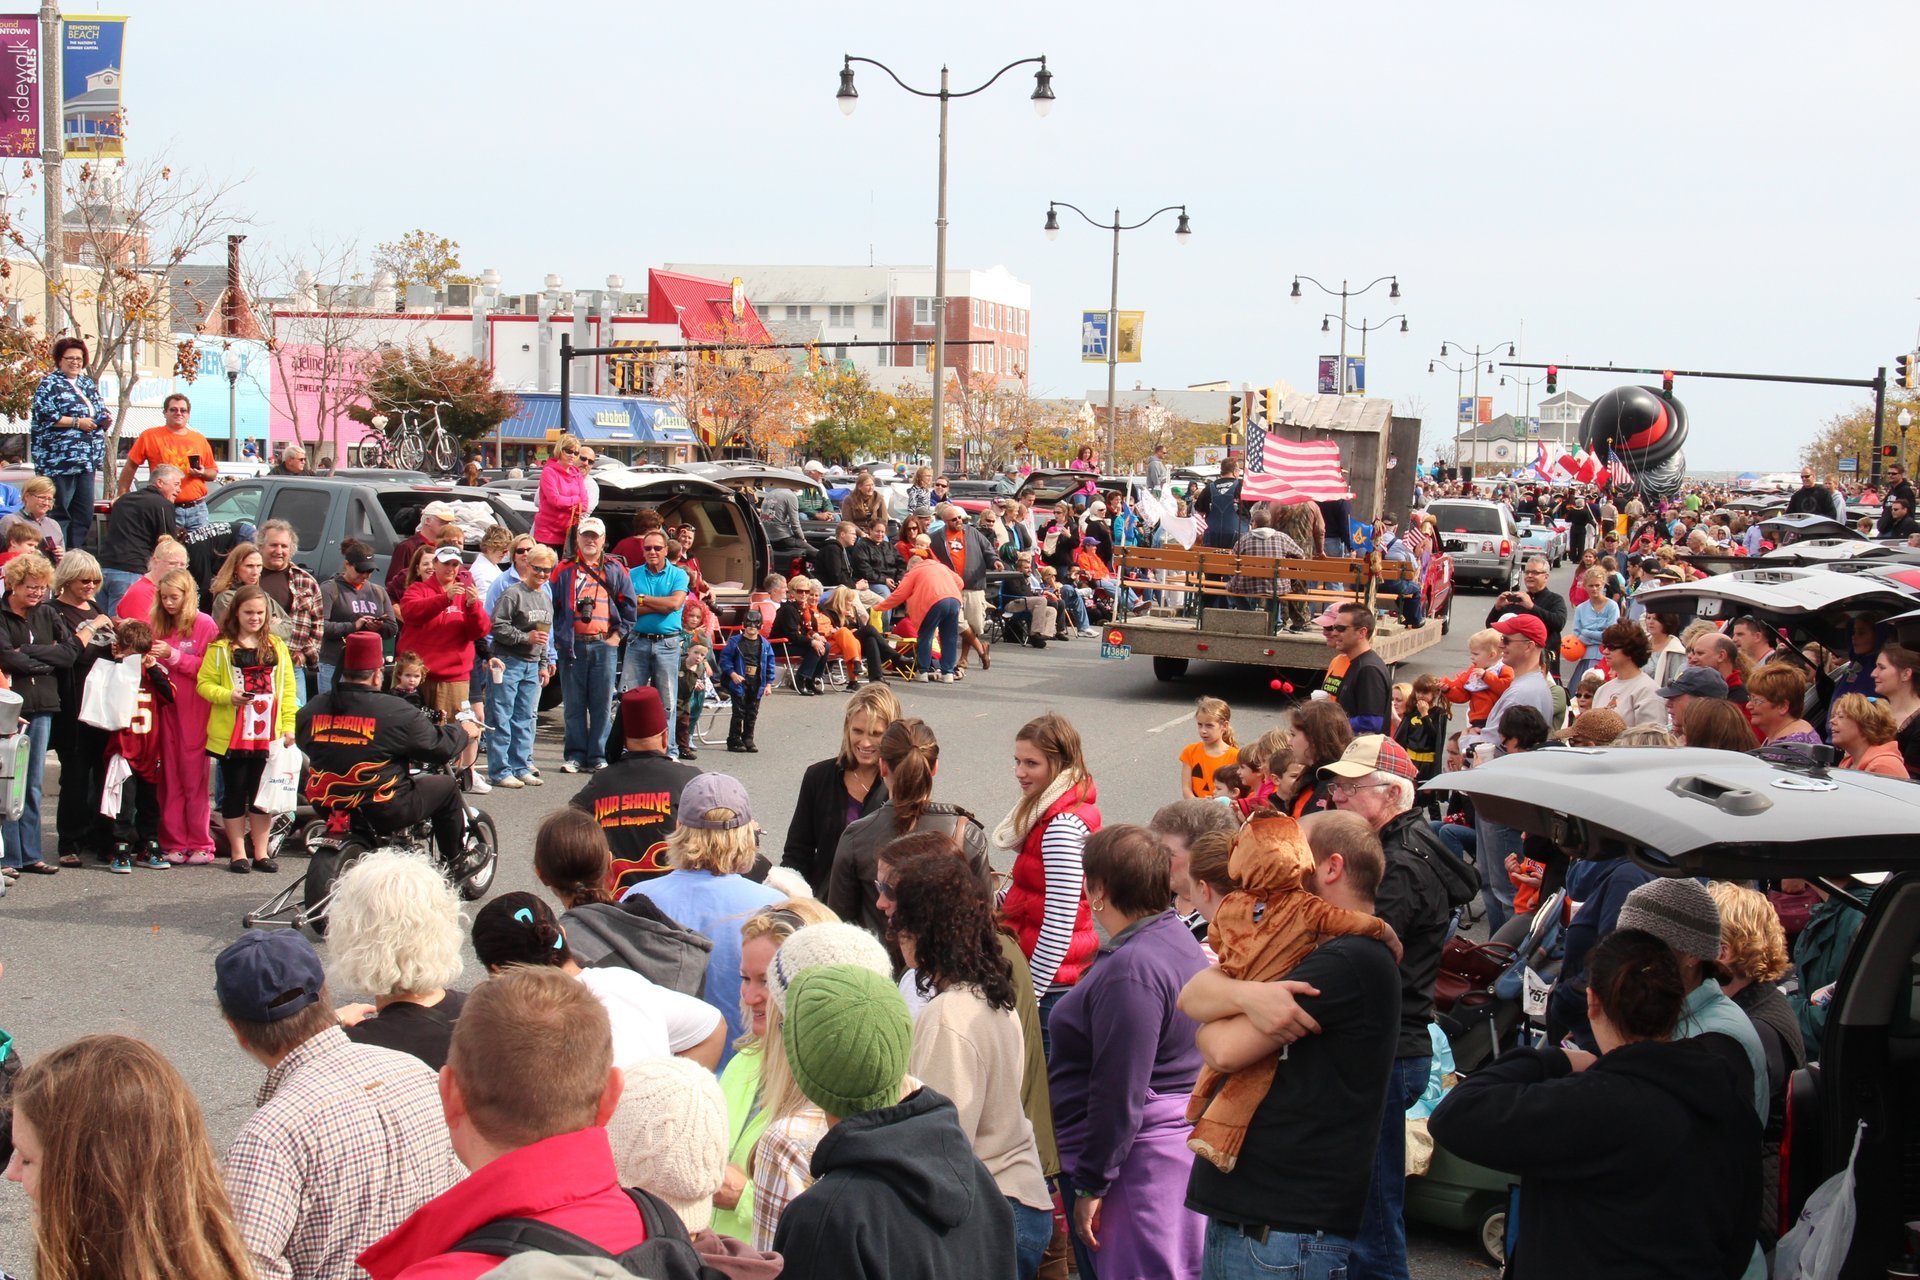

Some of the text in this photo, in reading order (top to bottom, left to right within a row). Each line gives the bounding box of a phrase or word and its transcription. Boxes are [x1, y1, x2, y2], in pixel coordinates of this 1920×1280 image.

[0, 20, 18, 28] ound
[68, 31, 99, 39] BEACH
[27, 48, 37, 84] SALES
[8, 40, 29, 122] sidewalk
[597, 409, 630, 424] rehoboth
[352, 600, 378, 615] GAP
[594, 792, 671, 822] NUR SHRINE
[620, 815, 665, 826] Choppers
